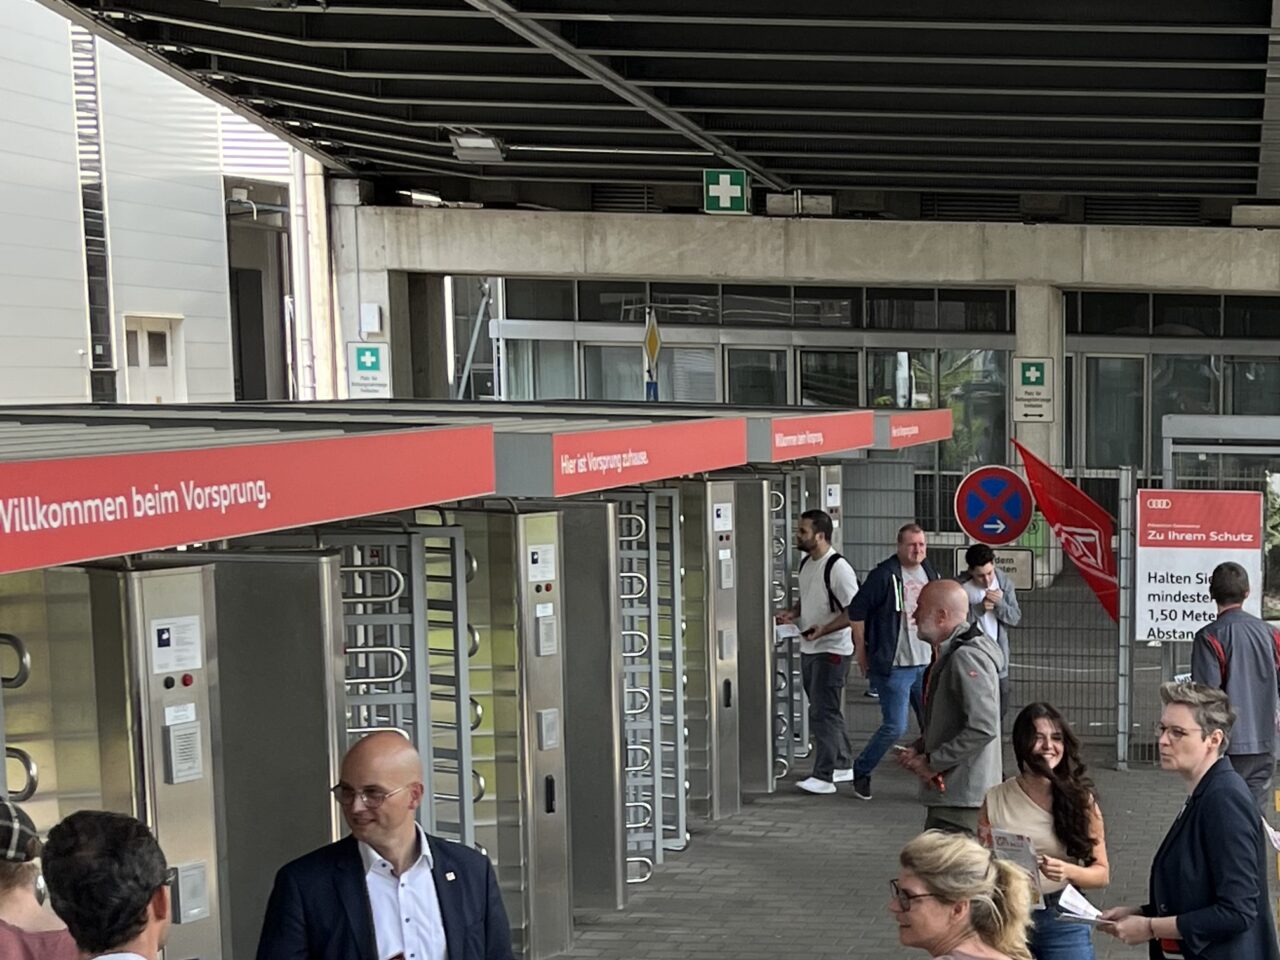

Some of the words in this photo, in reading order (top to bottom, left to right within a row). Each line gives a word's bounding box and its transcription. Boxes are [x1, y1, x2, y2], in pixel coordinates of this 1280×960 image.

[132, 484, 179, 518] beim
[180, 480, 271, 514] Vorsprung.
[1147, 530, 1164, 540] Zu
[1168, 530, 1206, 541] Ihrem
[1209, 531, 1254, 542] Schutz
[1147, 571, 1191, 585] Halten
[1148, 609, 1178, 622] 1,50
